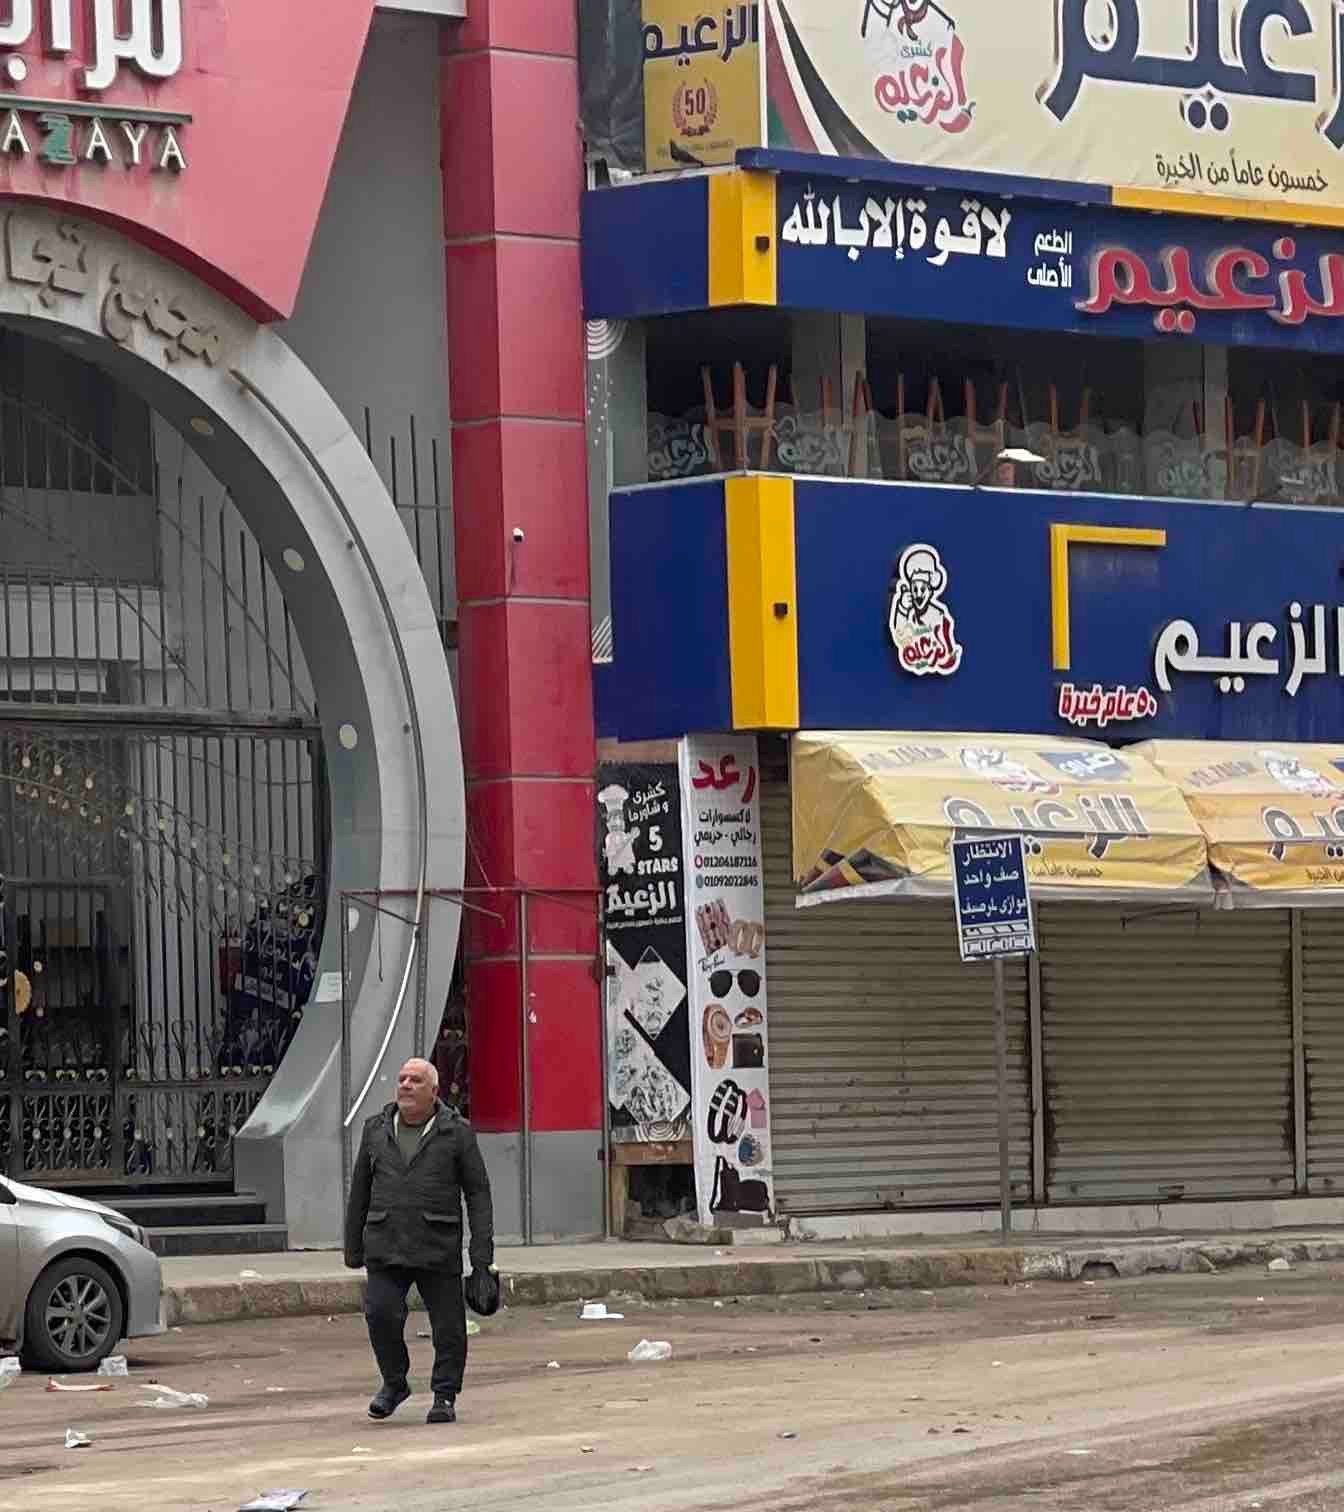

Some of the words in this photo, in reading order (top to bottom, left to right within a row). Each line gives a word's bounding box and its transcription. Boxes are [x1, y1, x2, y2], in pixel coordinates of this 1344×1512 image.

[684, 87, 706, 116] 50
[1155, 152, 1203, 184] الخبرة
[1207, 160, 1230, 186] من
[1268, 162, 1329, 193] خمسون
[1033, 230, 1073, 256] الطعم
[1059, 683, 1103, 727] خبرة
[1097, 685, 1136, 727] عام
[691, 753, 756, 805] رعد
[648, 824, 664, 852] 5
[637, 856, 679, 876] STARS
[961, 840, 1013, 866] الانتظار
[963, 868, 992, 888] واحد
[993, 866, 1020, 882] صف
[606, 880, 678, 917] الزعيم
